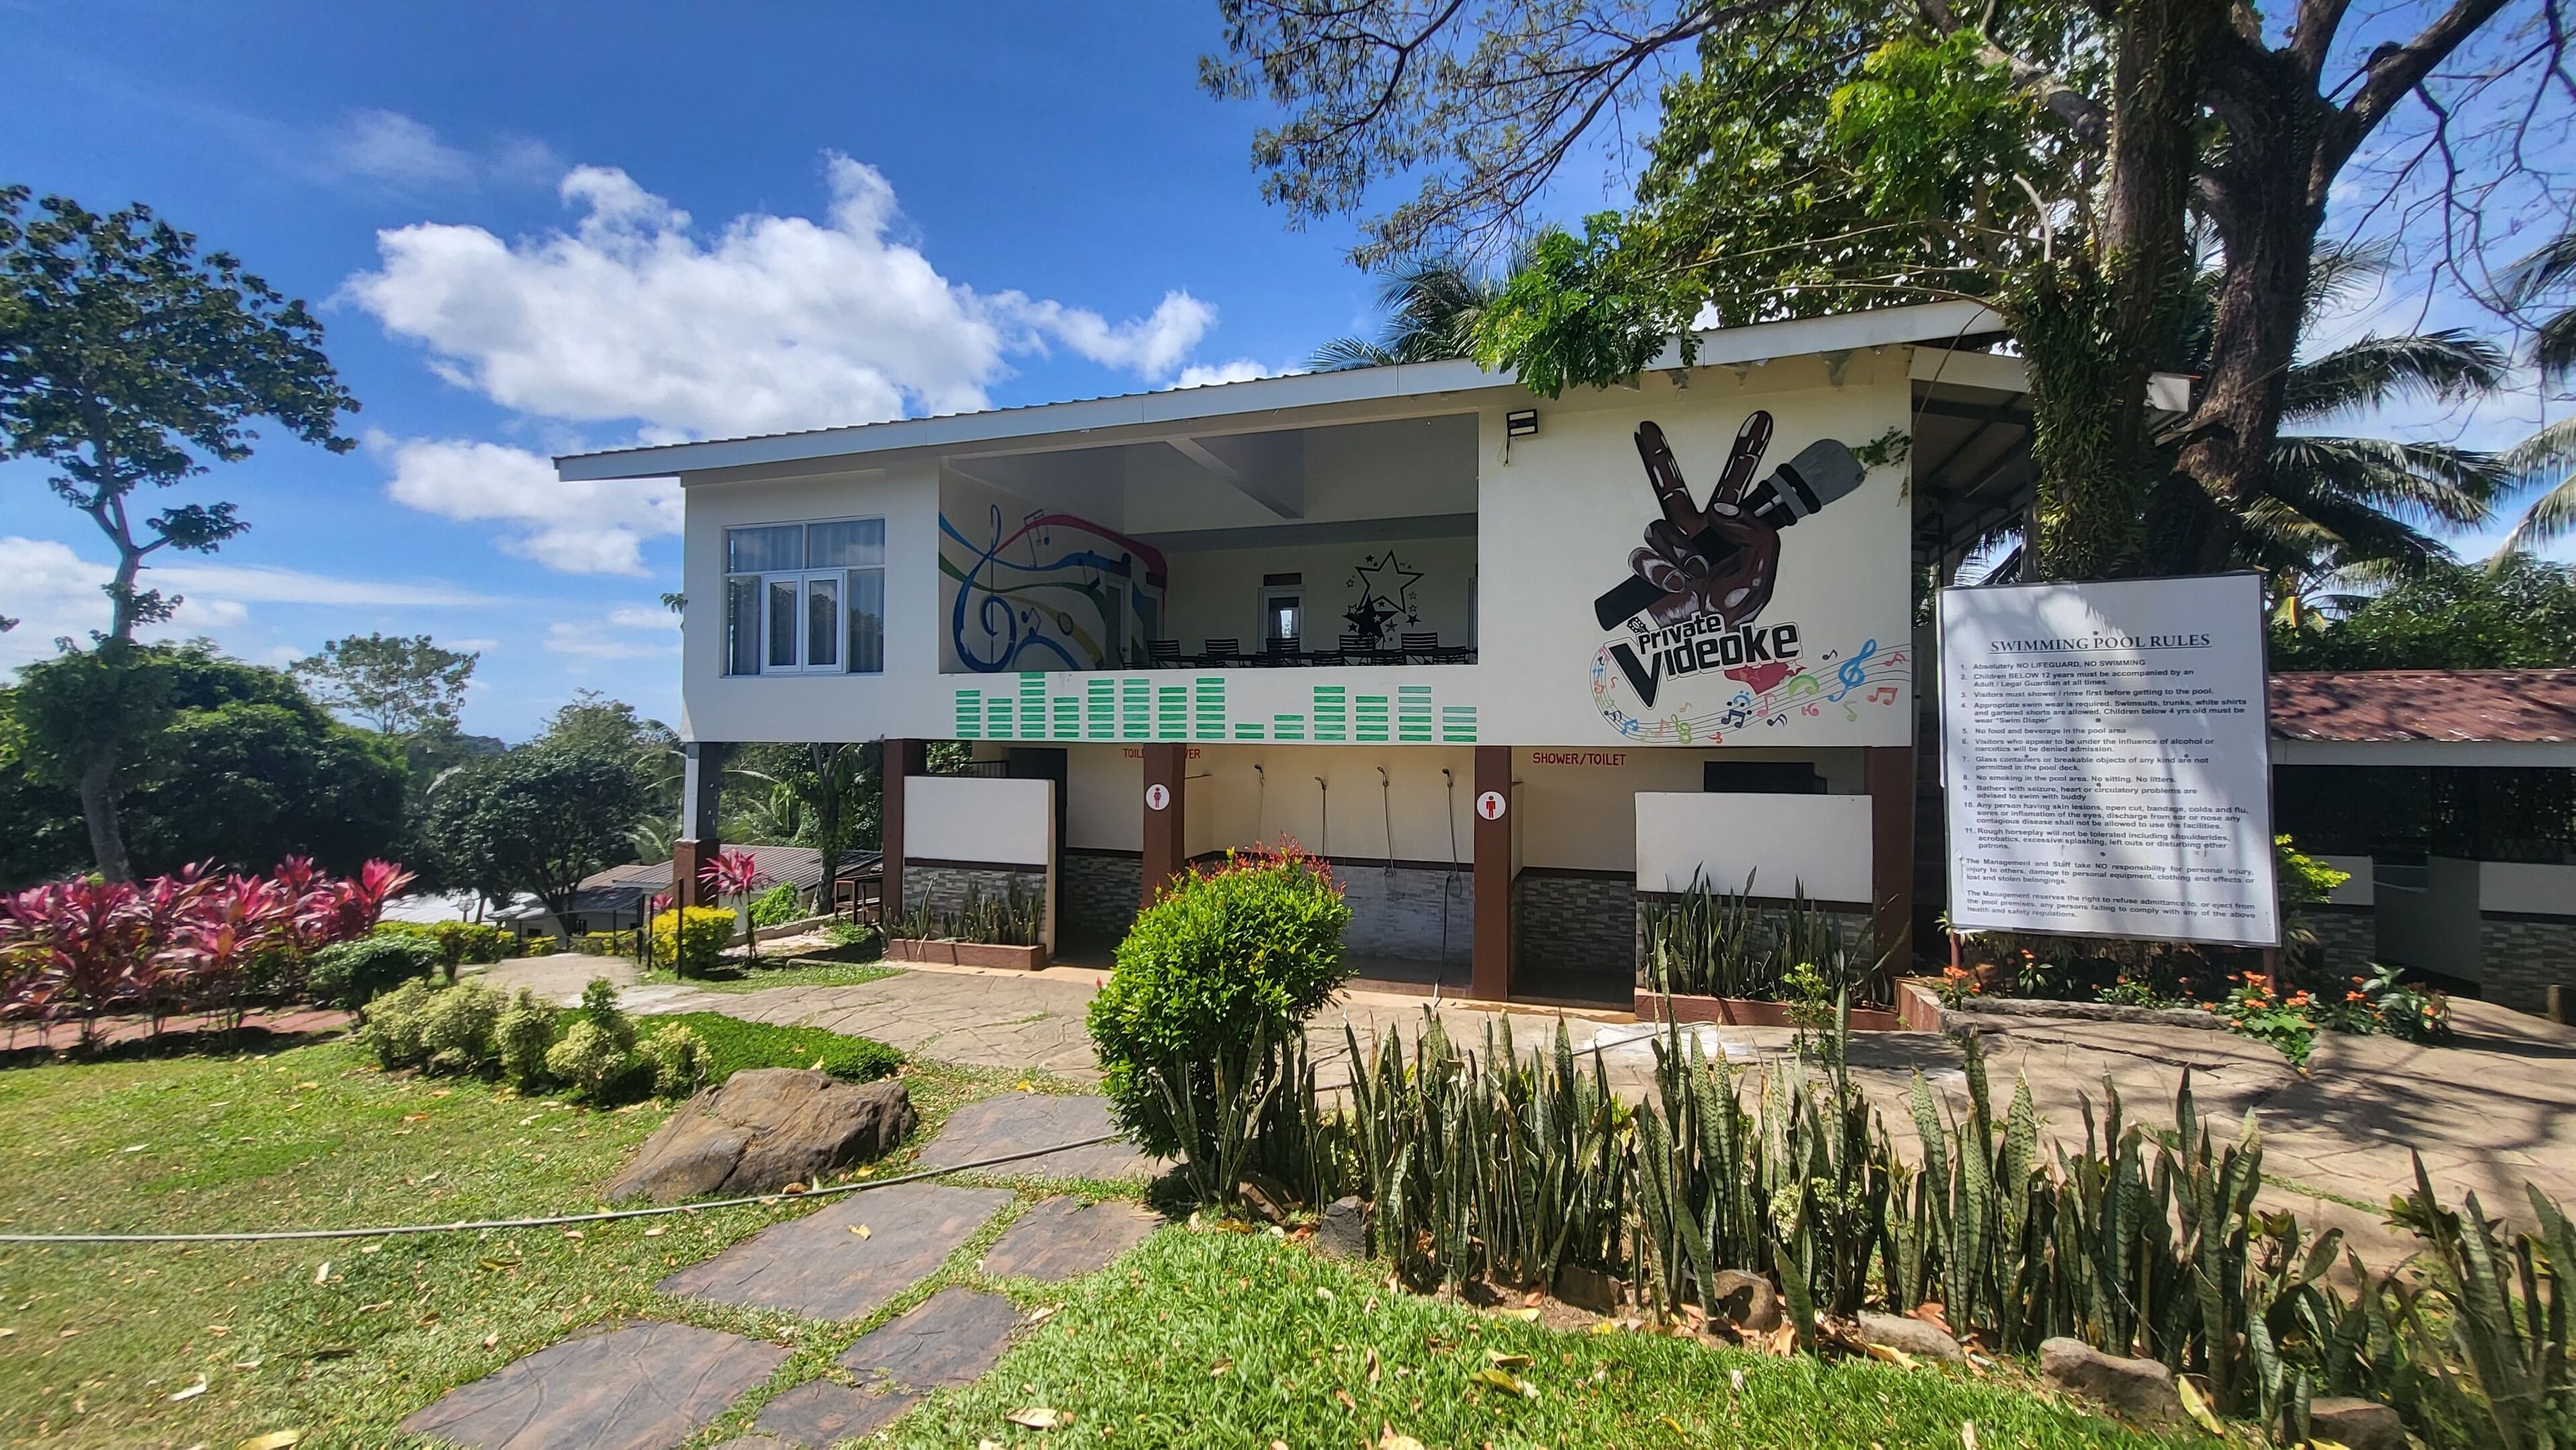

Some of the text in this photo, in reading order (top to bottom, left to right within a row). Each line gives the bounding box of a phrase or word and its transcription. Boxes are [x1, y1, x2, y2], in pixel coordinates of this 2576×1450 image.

[1638, 612, 1722, 655] Private
[1990, 634, 2210, 652] SWIMMING POOL RULES
[1608, 625, 1800, 708] Videoke
[2112, 670, 2167, 678] accompanied
[1974, 701, 2019, 709] Appropriate
[1532, 752, 1627, 766] SHOWER/TOILET
[1977, 817, 2019, 825] contagious
[2023, 876, 2066, 885] belongings.
